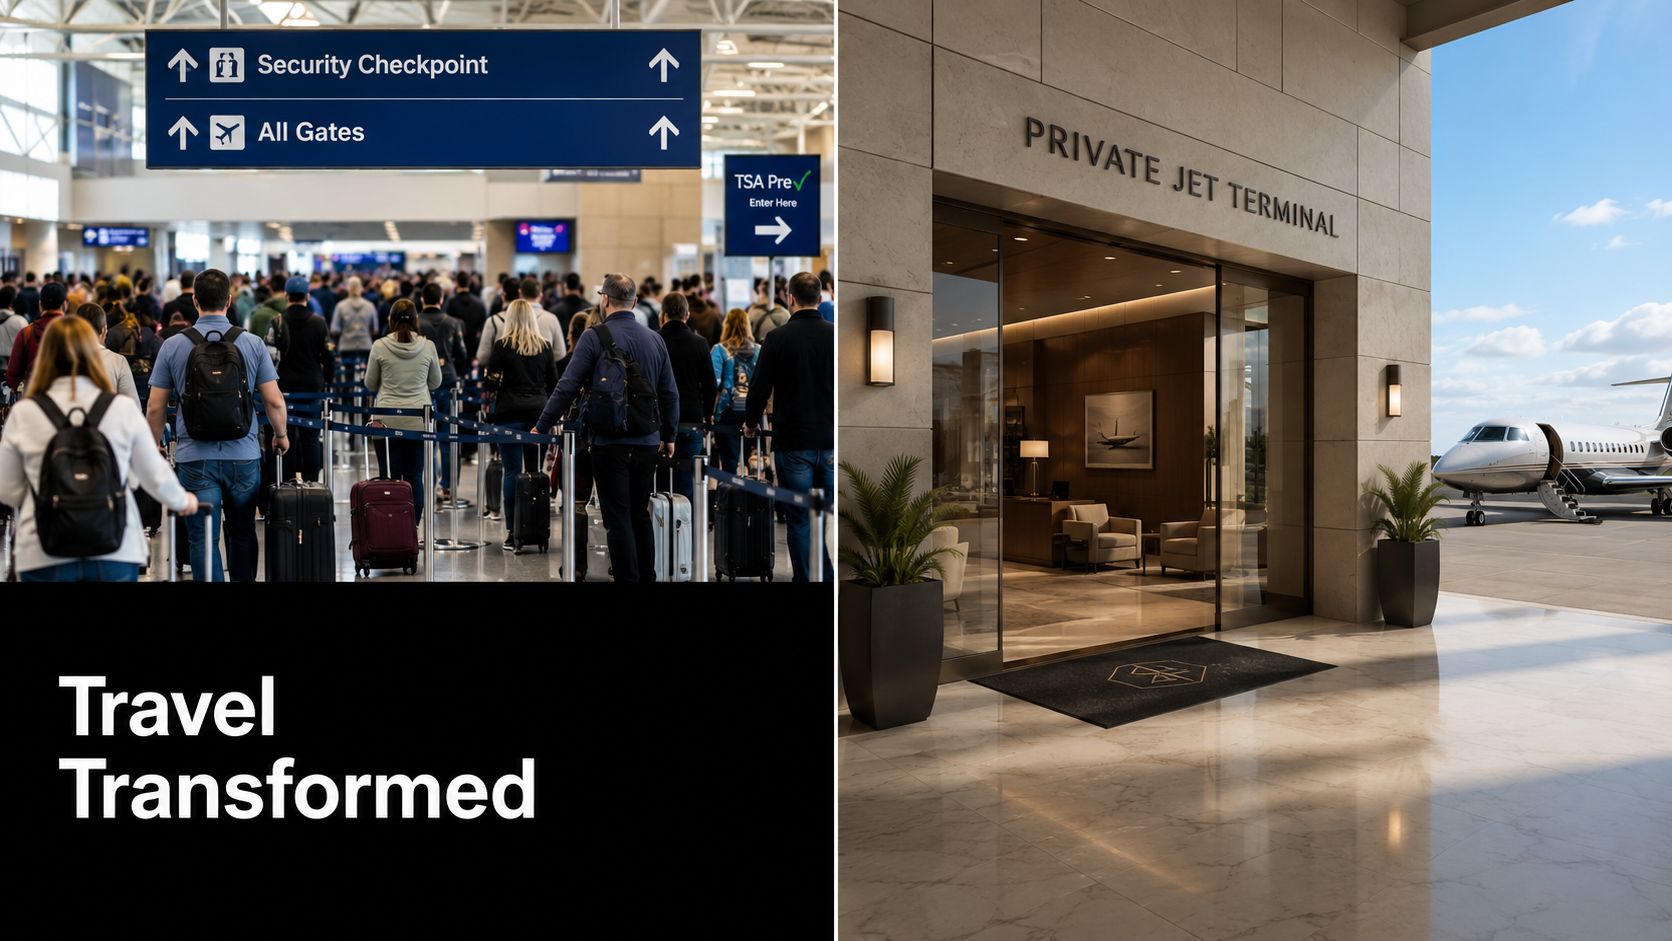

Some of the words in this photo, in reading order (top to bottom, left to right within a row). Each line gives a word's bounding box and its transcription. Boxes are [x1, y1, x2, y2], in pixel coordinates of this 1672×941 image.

[257, 53, 353, 79] Security
[358, 53, 489, 80] Checkpoint
[257, 121, 288, 142] All
[295, 121, 365, 142] Gates
[734, 174, 765, 189] TSA
[768, 174, 793, 189] Pre
[1025, 116, 1161, 186] PRIVATE
[1172, 166, 1219, 201] JET
[1228, 181, 1340, 239] TERMINAL
[749, 198, 774, 208] Enter
[775, 198, 798, 208] Here
